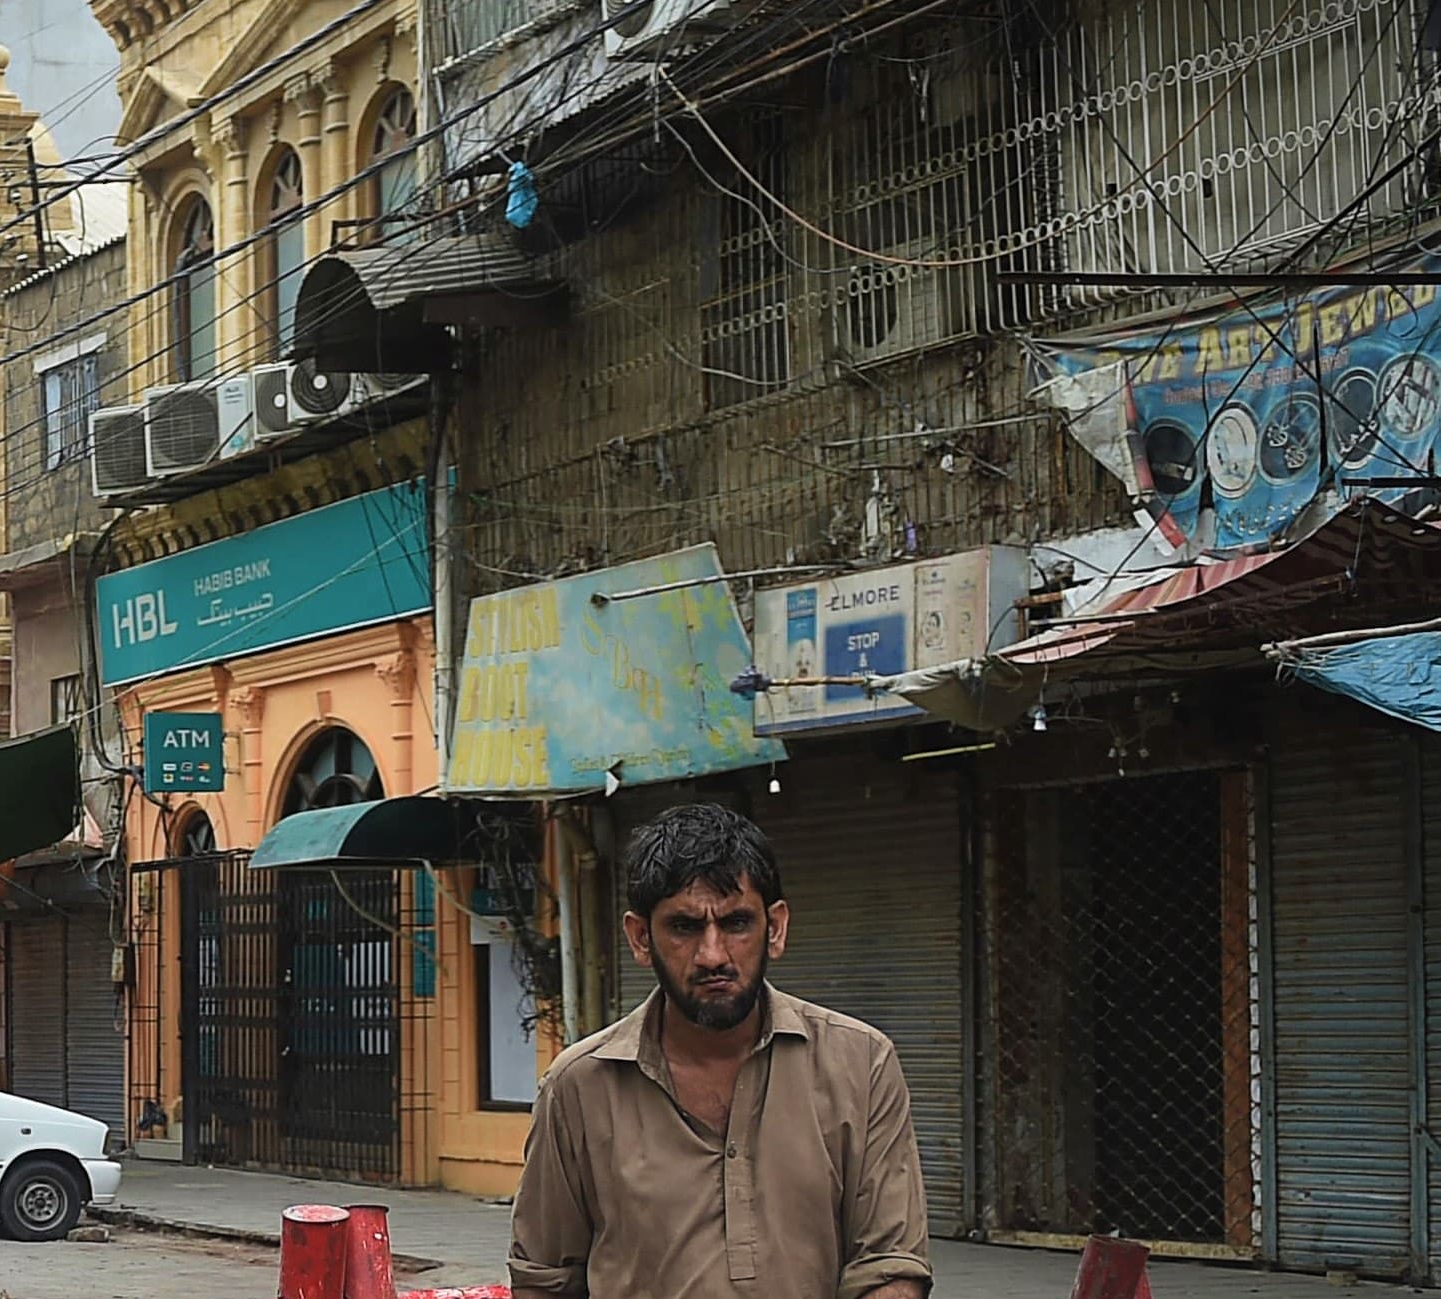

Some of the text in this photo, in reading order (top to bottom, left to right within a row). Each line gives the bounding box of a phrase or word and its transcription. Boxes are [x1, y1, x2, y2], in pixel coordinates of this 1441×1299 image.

[1193, 325, 1281, 376] ART
[193, 559, 271, 597] HABIB BANK
[825, 585, 900, 612] ELMORE
[112, 589, 179, 649] HBL
[470, 586, 560, 659] STYLISH
[847, 632, 880, 652] STOP
[859, 653, 868, 667] &
[460, 661, 528, 723] BOOT
[163, 730, 211, 748] ATM
[449, 726, 549, 787] HOUSE
